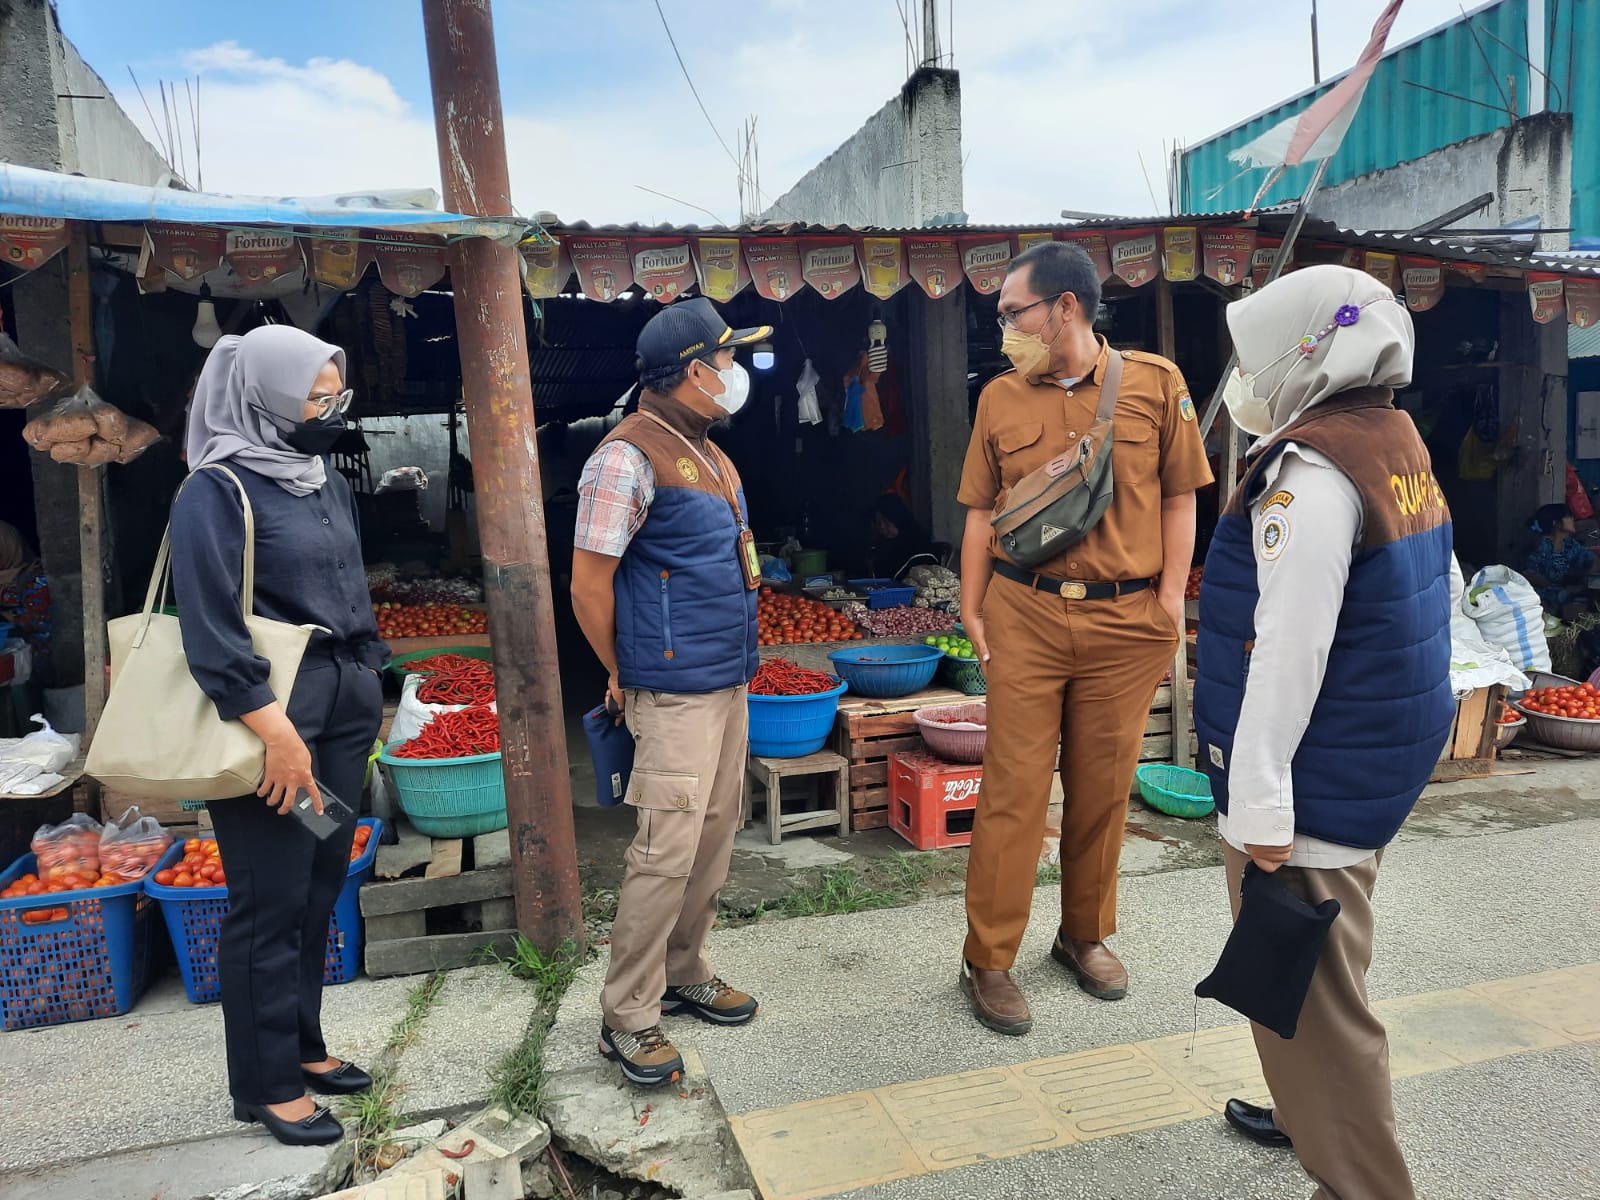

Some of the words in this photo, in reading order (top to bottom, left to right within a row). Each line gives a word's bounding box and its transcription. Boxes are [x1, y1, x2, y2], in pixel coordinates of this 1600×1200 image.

[234, 235, 288, 249] Fortune
[572, 241, 607, 250] KUALITAS
[970, 249, 1008, 265] Fortune
[1117, 243, 1154, 258] Fortune
[642, 254, 685, 269] Fortune
[811, 253, 850, 268] Fortune
